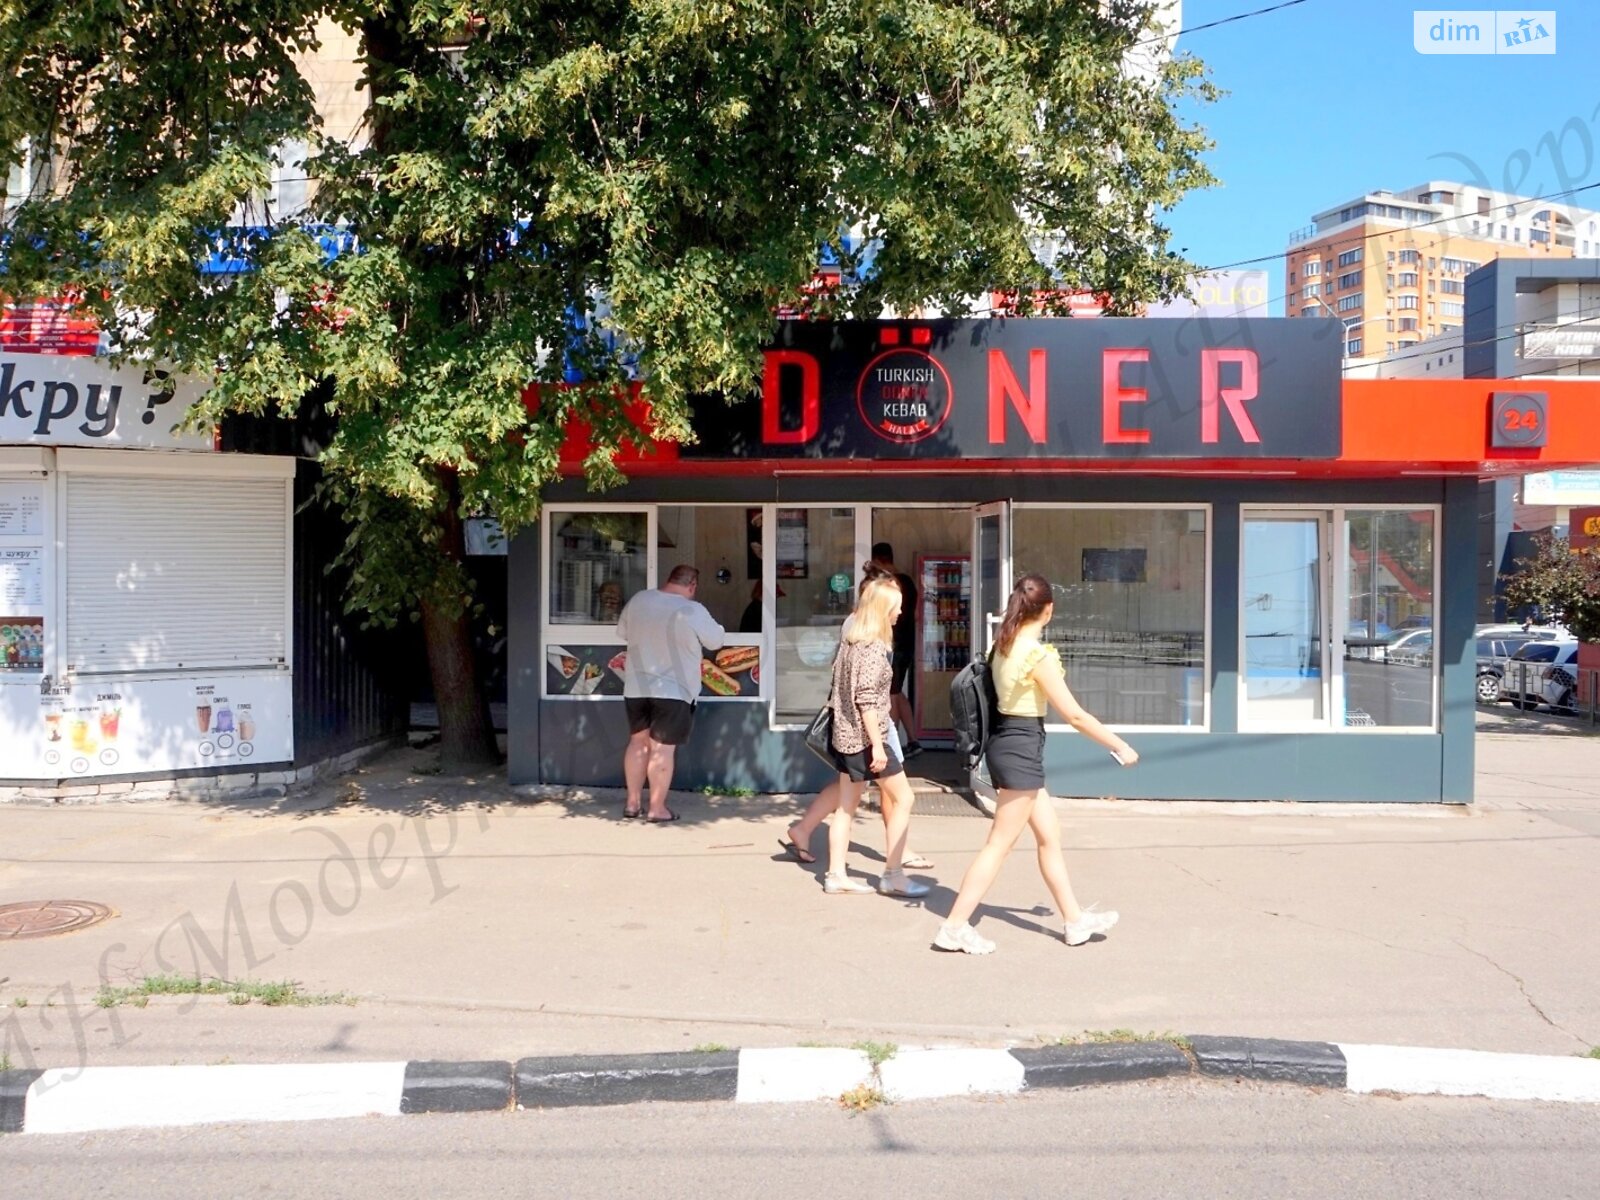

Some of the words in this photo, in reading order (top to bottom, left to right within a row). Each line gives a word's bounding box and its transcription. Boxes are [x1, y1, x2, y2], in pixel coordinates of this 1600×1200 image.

[1553, 345, 1595, 356] КЛУБ
[876, 368, 935, 383] TURKISH
[883, 403, 928, 417] KEBAB
[1504, 409, 1538, 430] 24
[888, 423, 921, 436] HALAL
